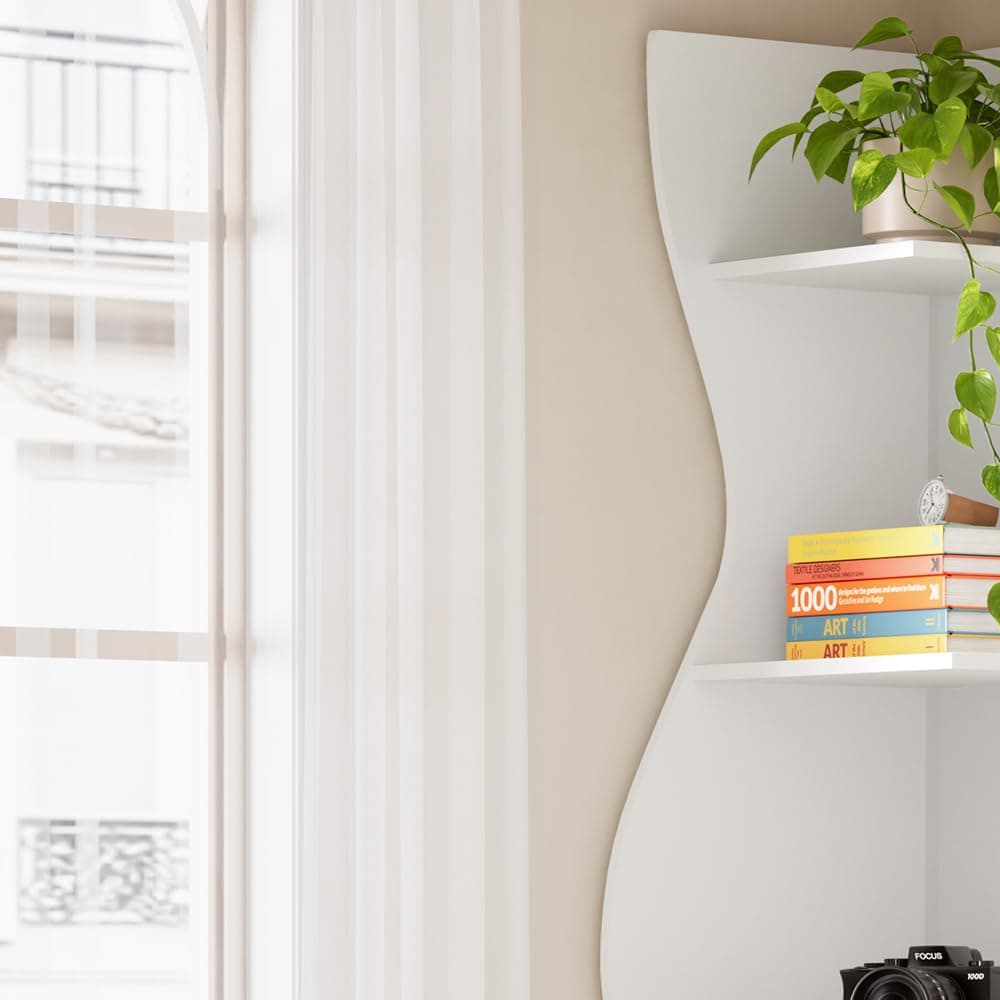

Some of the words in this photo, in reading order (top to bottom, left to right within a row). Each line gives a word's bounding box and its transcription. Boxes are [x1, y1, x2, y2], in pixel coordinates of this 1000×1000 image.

[791, 584, 838, 612] 1000
[823, 617, 849, 636] ART
[823, 643, 848, 659] ART
[914, 952, 943, 960] FOCUS
